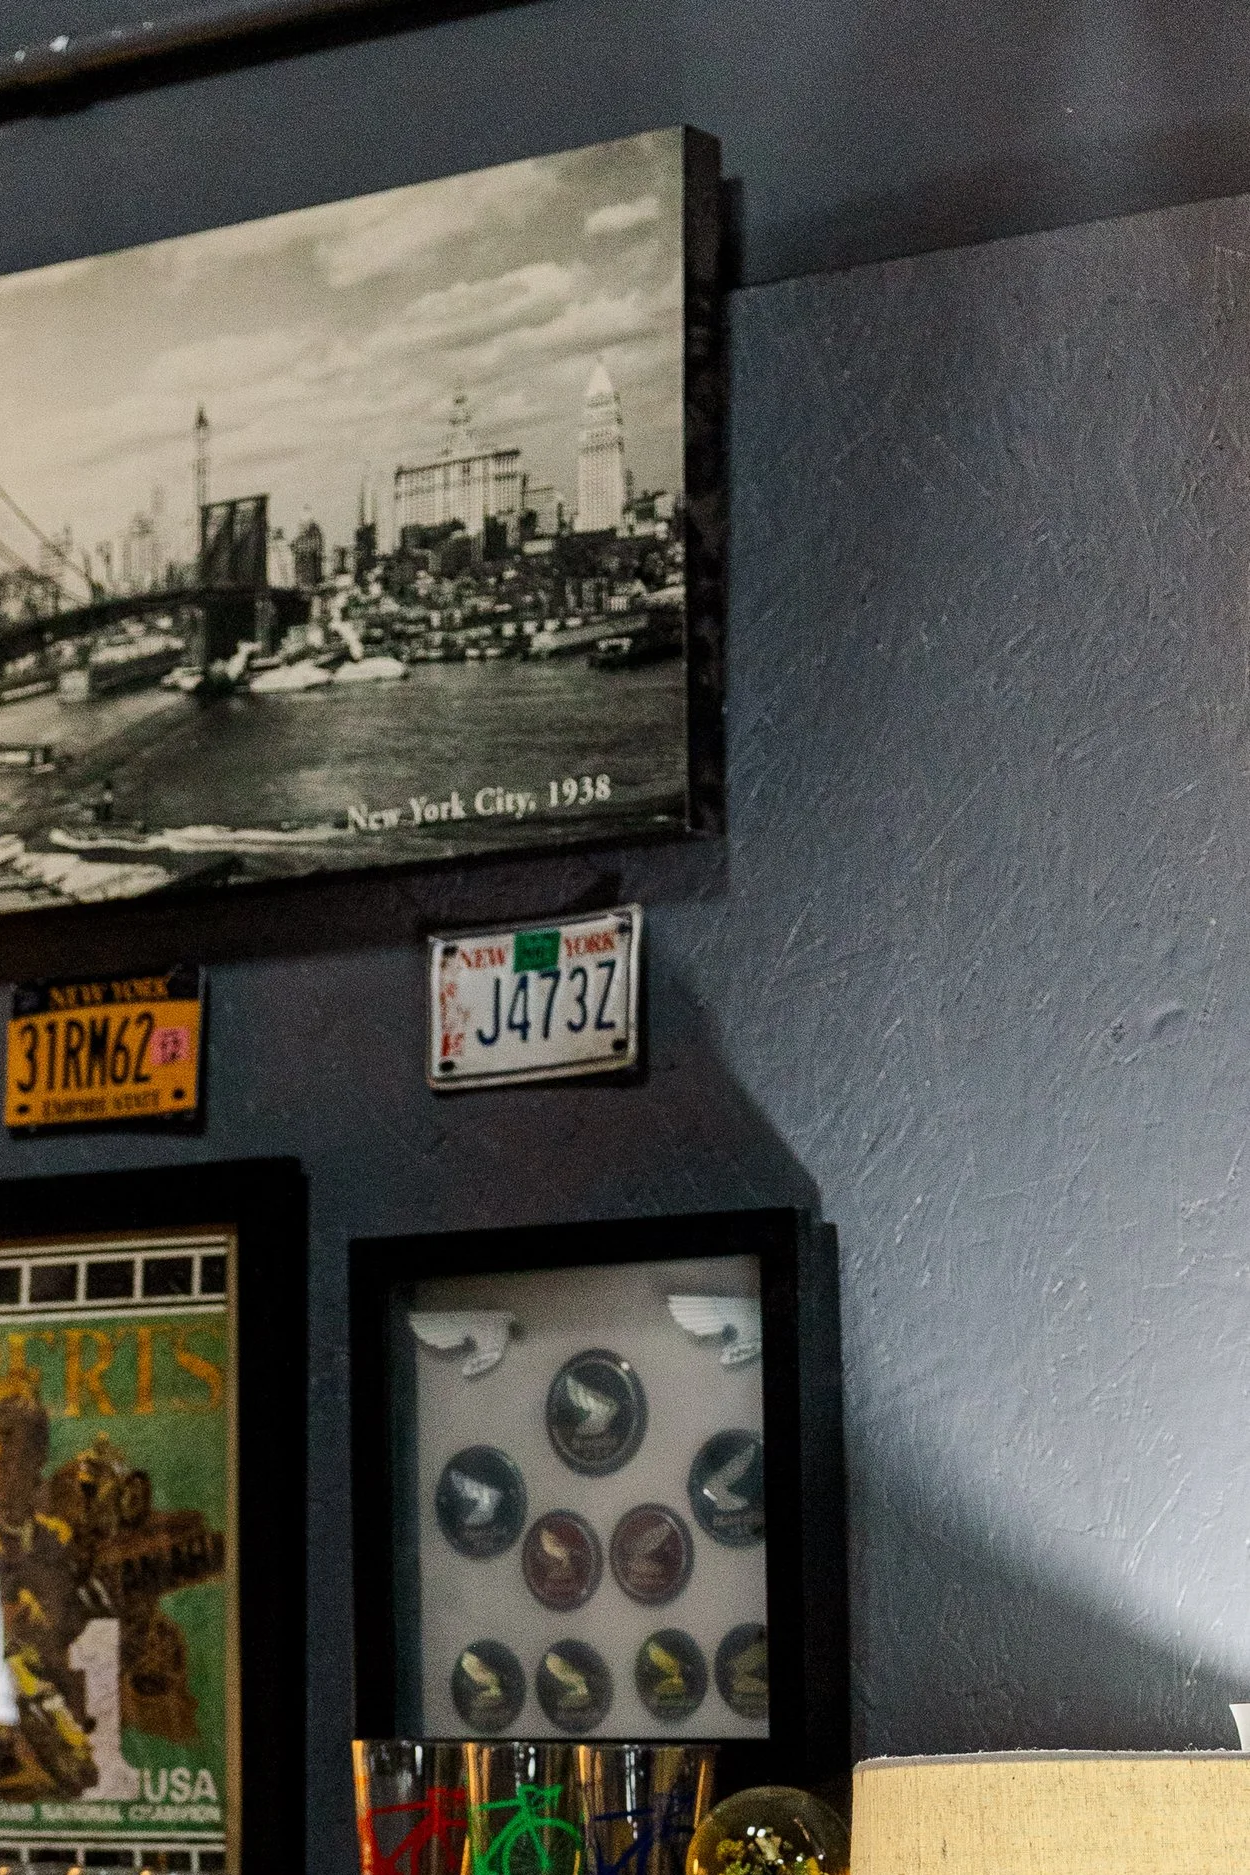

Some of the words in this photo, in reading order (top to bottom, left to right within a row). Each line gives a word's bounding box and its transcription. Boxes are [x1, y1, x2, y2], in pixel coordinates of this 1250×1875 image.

[347, 803, 402, 833] New
[409, 792, 466, 824] York
[474, 787, 537, 819] City,
[548, 774, 612, 808] 1938
[458, 946, 508, 969] NEW
[564, 931, 616, 958] YORK
[475, 958, 617, 1046] J473Z
[15, 1010, 156, 1093] 31RM62
[67, 1617, 145, 1802] 1
[142, 1768, 219, 1803] USA
